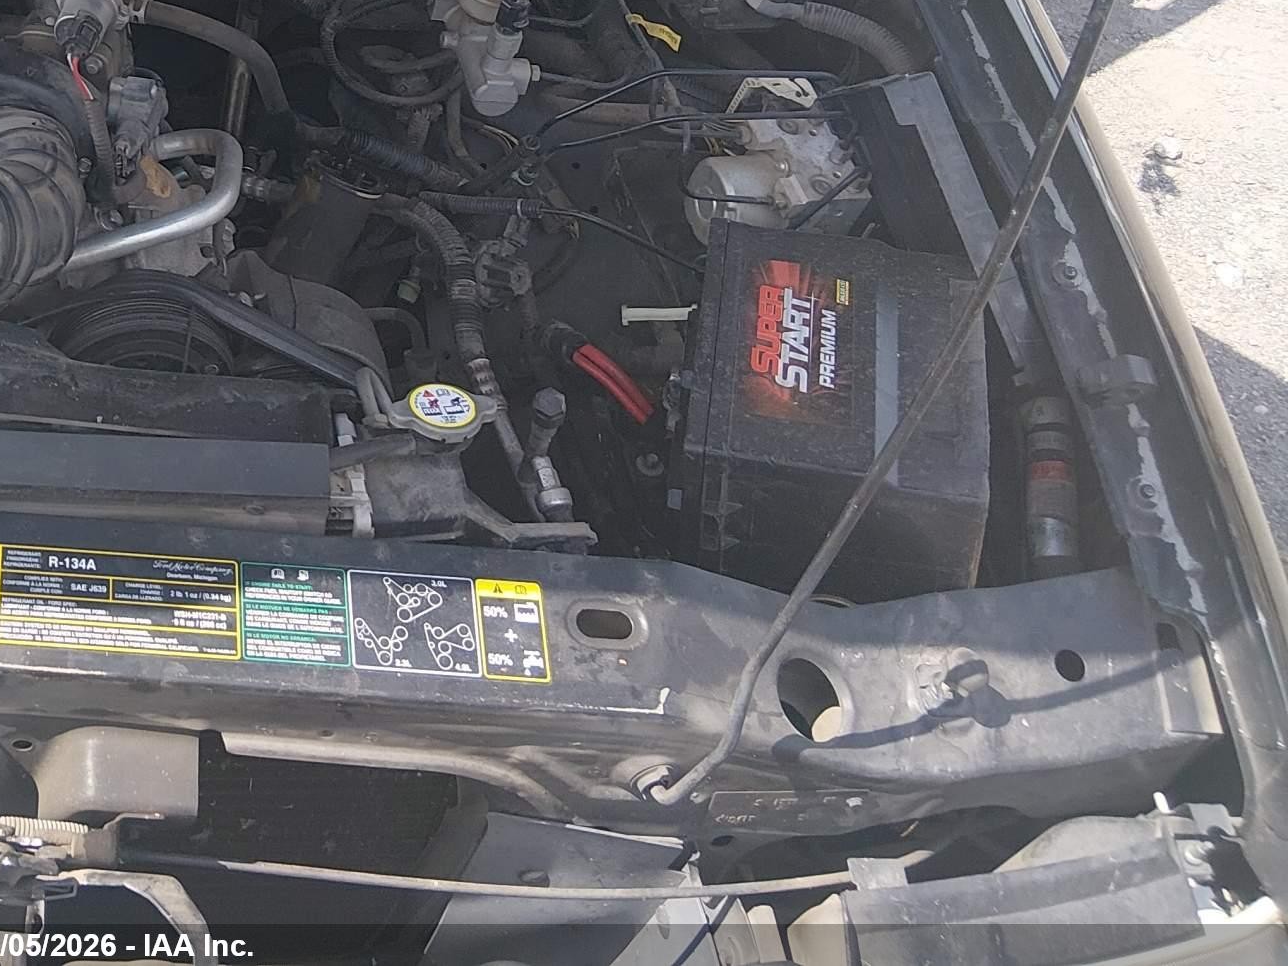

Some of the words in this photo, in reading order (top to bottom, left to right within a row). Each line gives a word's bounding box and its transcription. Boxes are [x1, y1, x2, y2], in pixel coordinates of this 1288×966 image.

[751, 285, 784, 373] SUPER
[775, 286, 811, 393] START
[819, 309, 837, 389] PREMIUM
[48, 555, 97, 571] R-134A
[70, 583, 87, 591] SAE
[483, 605, 509, 619] 50%
[487, 652, 514, 666] 50%
